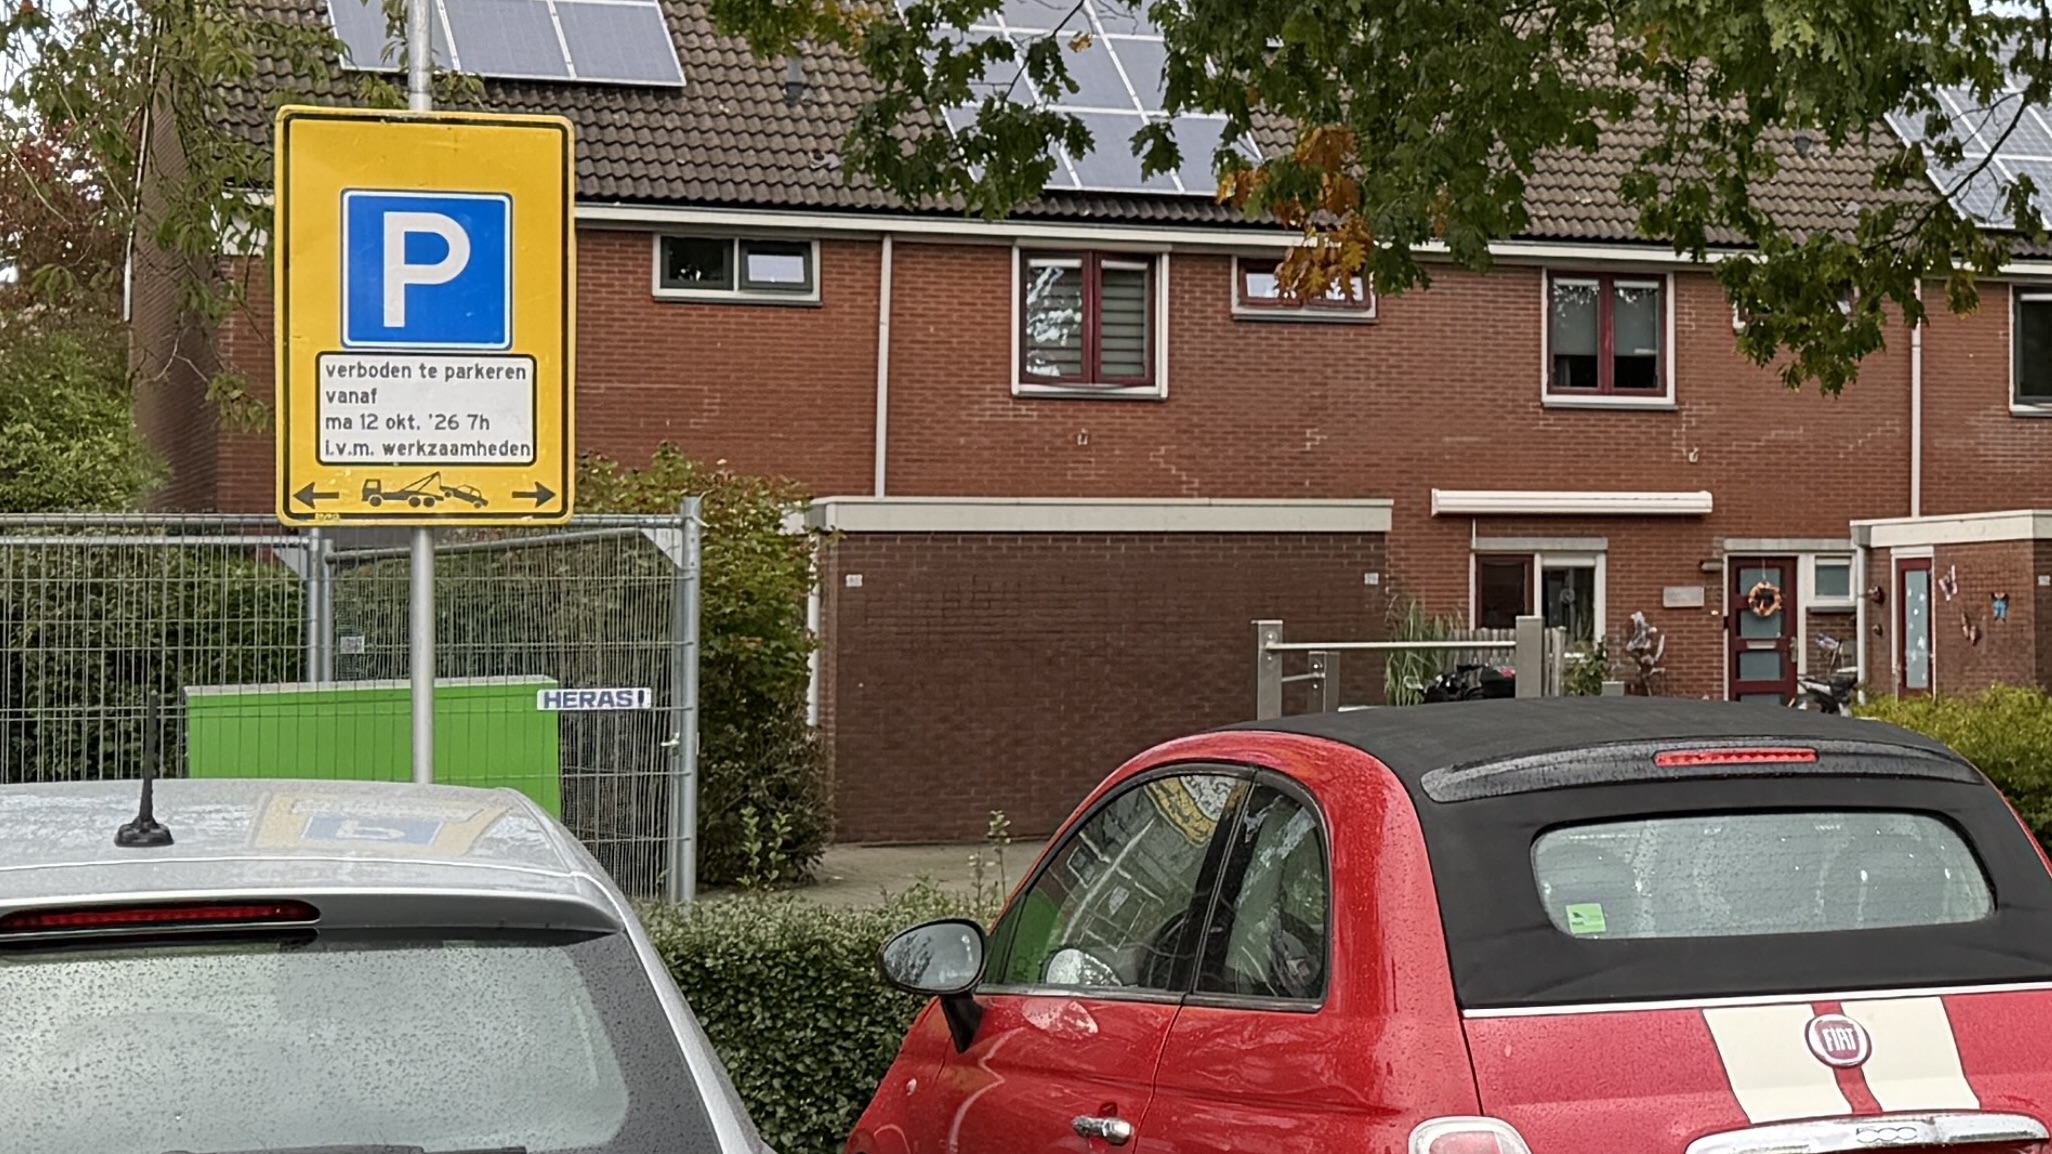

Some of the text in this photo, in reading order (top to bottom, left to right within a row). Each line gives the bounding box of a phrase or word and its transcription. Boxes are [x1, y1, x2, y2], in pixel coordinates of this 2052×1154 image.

[383, 211, 471, 328] P
[325, 361, 526, 382] verboden te parkeren
[325, 387, 377, 404] vanaf
[325, 413, 490, 430] ma 12 okt. '26 7h
[382, 440, 531, 457] werkzaamheden
[1821, 1027, 1857, 1052] FIAT
